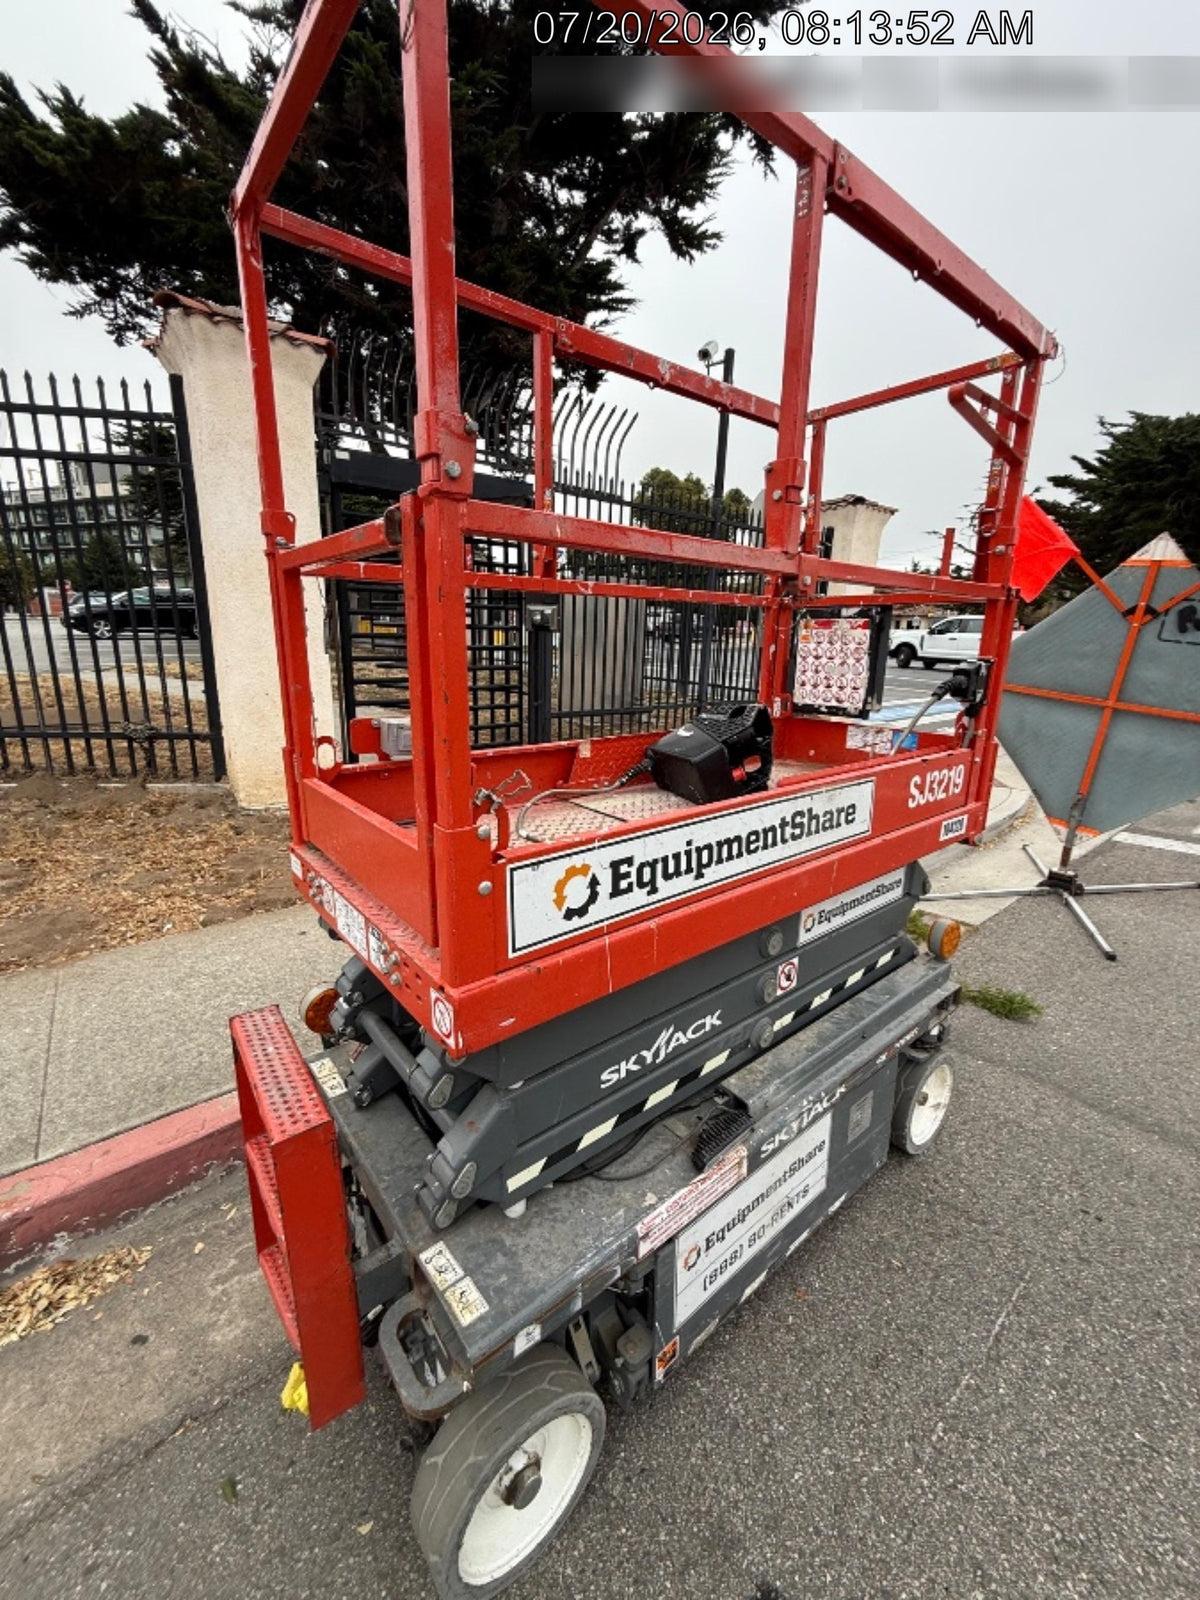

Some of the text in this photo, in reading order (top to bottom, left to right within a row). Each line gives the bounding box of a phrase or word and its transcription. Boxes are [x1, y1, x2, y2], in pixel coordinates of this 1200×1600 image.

[907, 764, 965, 809] SJ3219
[609, 802, 856, 900] EquipmentShare
[817, 878, 902, 925] EquipmentShare
[600, 1009, 722, 1089] SKYJACK
[703, 1243, 744, 1292] (888)
[748, 1183, 810, 1249] 80-RENTS
[705, 1139, 826, 1252] EquipmentShare
